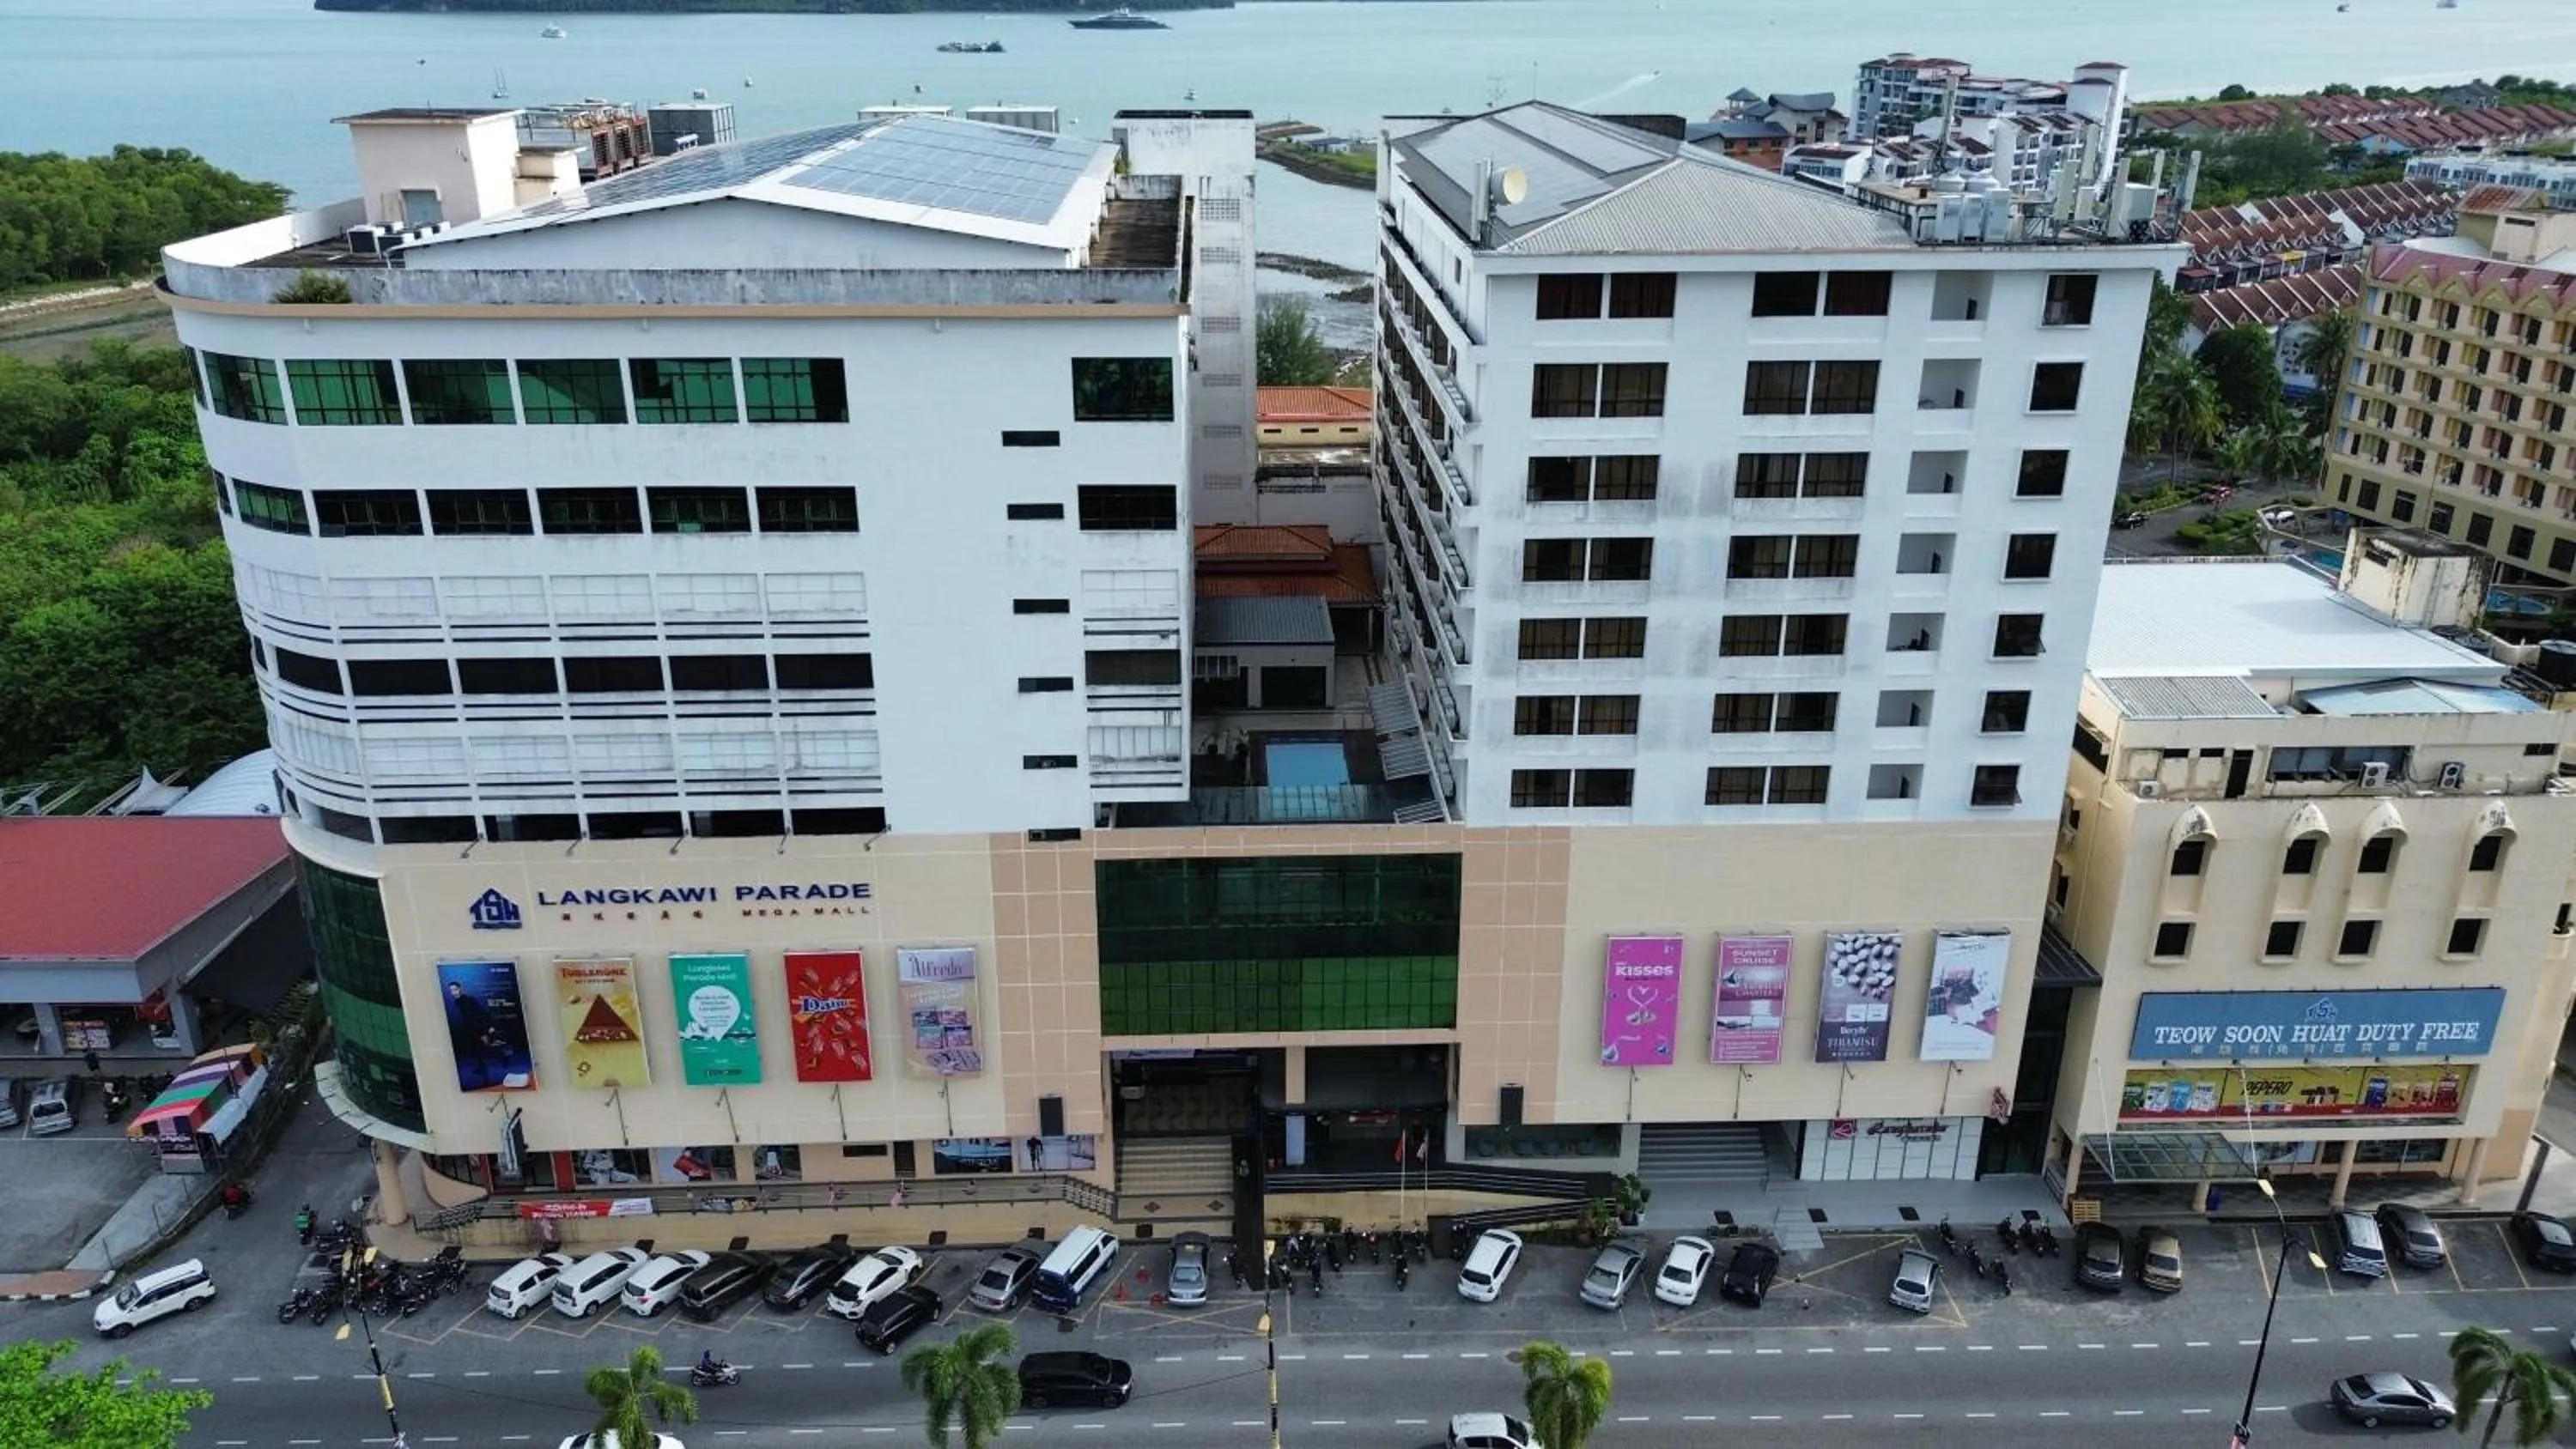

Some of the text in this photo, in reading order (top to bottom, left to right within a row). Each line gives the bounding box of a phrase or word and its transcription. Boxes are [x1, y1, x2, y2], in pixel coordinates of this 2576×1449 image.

[538, 883, 871, 906] LANGKAWI PARADE
[742, 906, 869, 917] MEGA MALL
[2154, 1022, 2481, 1045] TEOW SOON HUAT DUTY FREE
